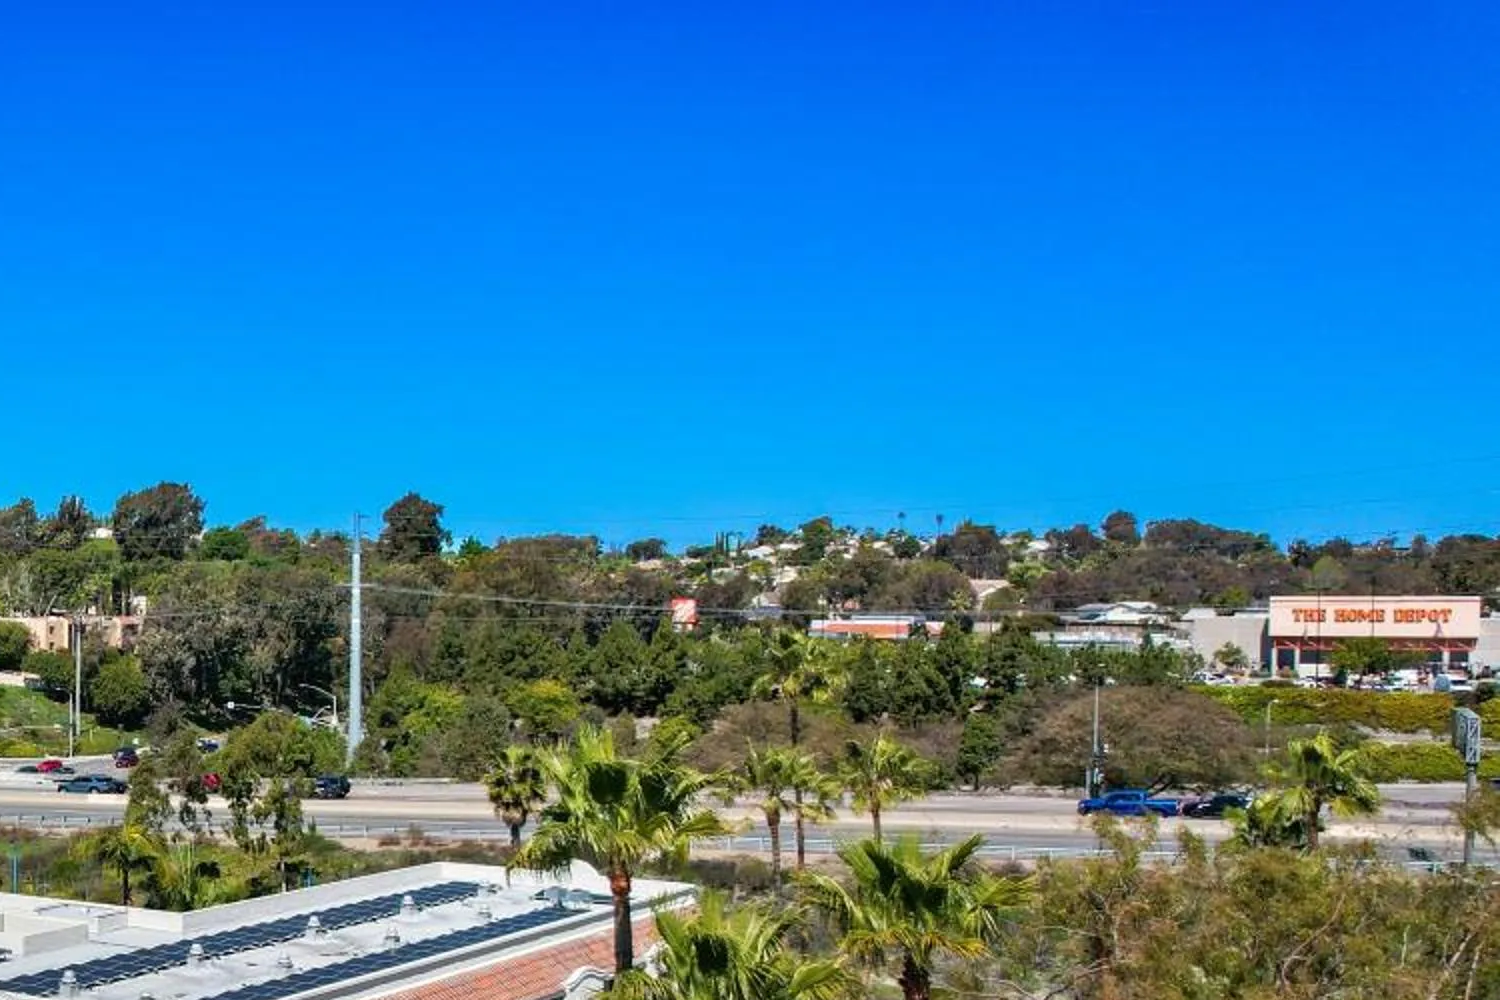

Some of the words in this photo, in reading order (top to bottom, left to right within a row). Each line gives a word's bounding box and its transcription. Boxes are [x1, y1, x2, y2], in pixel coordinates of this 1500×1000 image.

[1292, 608, 1326, 623] THE
[1334, 608, 1386, 623] HOME
[1393, 608, 1453, 623] DEPOT
